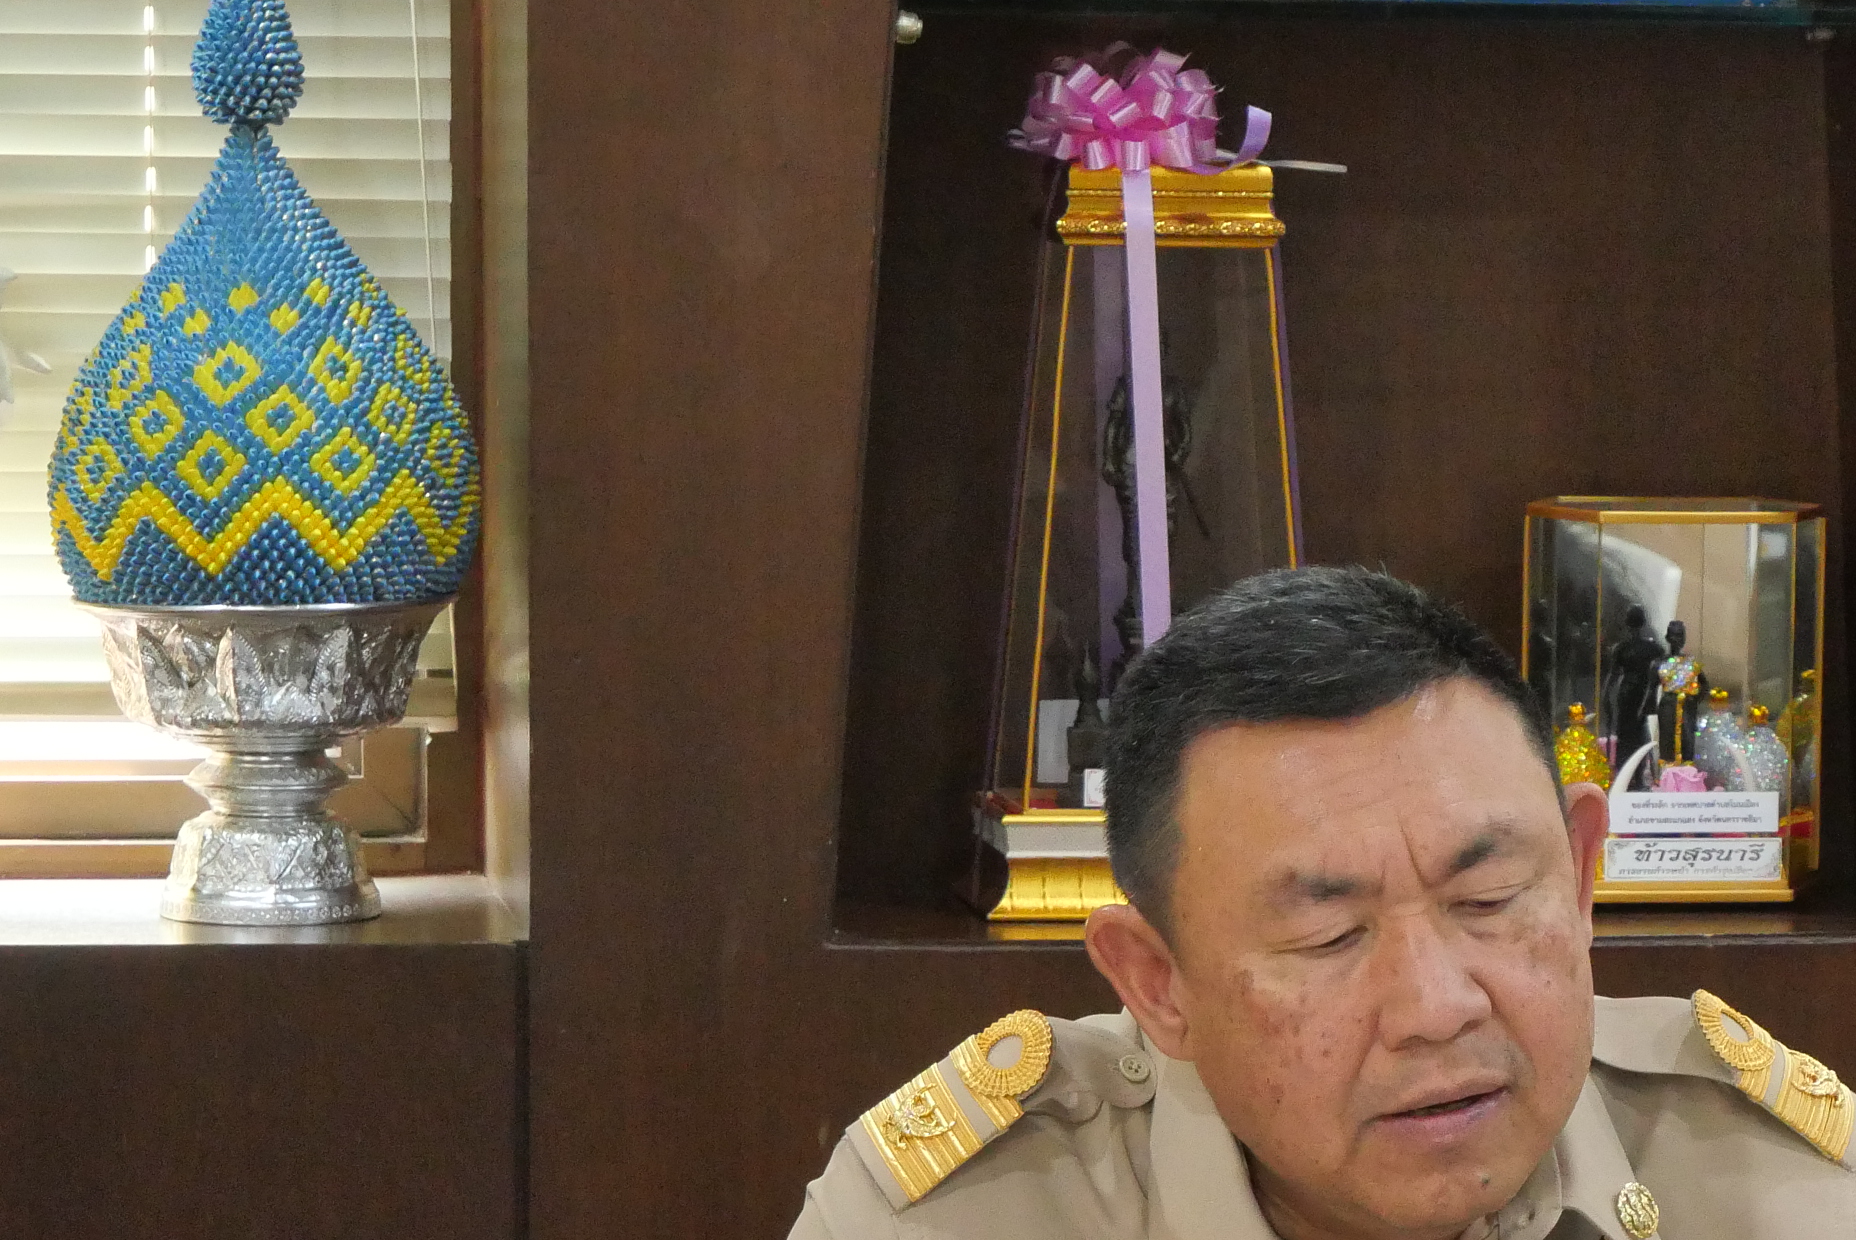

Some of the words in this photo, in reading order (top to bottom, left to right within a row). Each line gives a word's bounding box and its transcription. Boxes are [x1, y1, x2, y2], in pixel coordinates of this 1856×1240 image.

[1634, 843, 1766, 867] ท้าวสุรนารี
